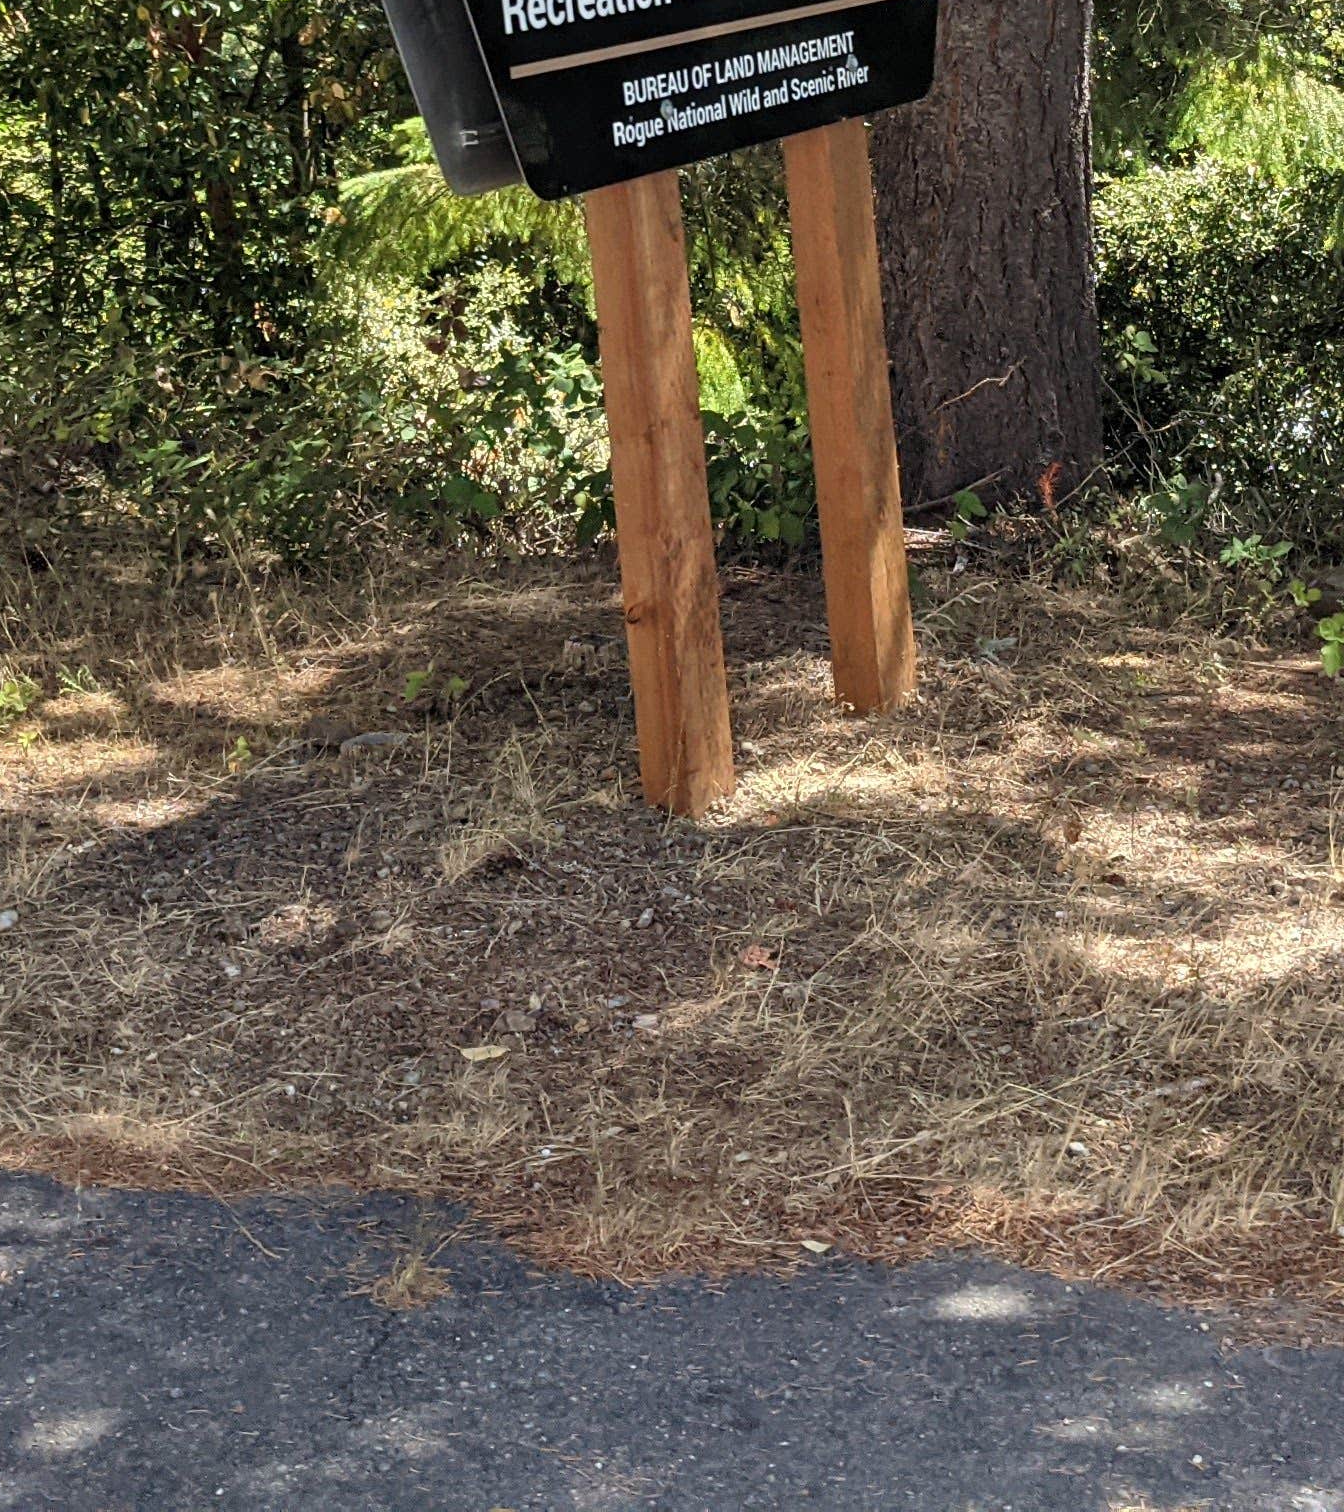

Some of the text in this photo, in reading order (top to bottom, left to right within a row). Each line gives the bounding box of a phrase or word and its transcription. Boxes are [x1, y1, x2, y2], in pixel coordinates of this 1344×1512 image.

[612, 66, 869, 147] Rogue National Wild and Scenic River
[622, 30, 854, 106] BUREAU OF LAND MANAGEMENT
